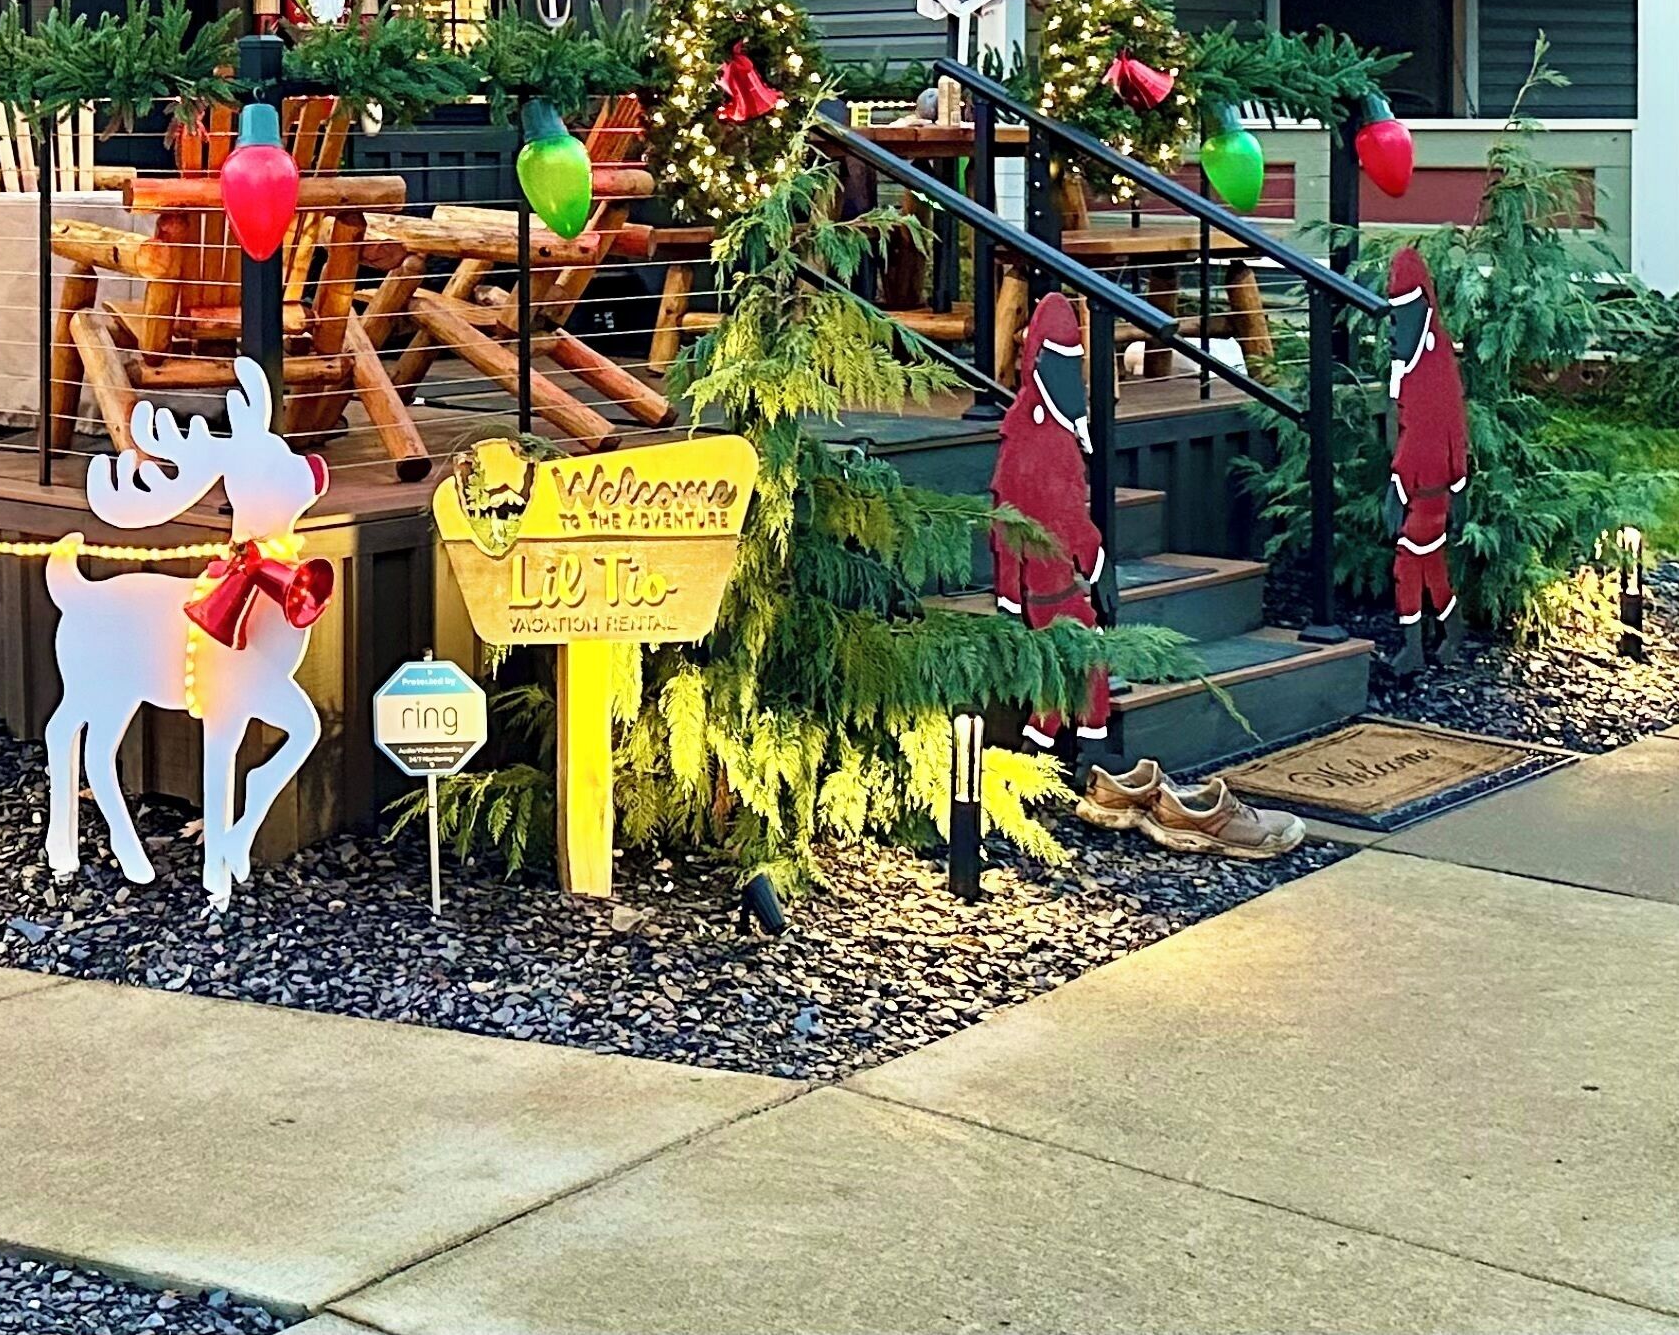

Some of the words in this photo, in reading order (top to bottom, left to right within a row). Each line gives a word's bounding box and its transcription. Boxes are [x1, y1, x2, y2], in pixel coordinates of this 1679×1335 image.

[551, 464, 738, 511] Welcome
[559, 513, 581, 531] TO
[588, 511, 621, 530] THE
[628, 512, 729, 530] ADVENTURE
[509, 552, 587, 609] Lil
[594, 551, 678, 608] Tio
[510, 616, 599, 633] VACATION
[606, 615, 679, 632] RENTAL
[402, 700, 458, 736] ring
[1288, 747, 1439, 788] Welcome
